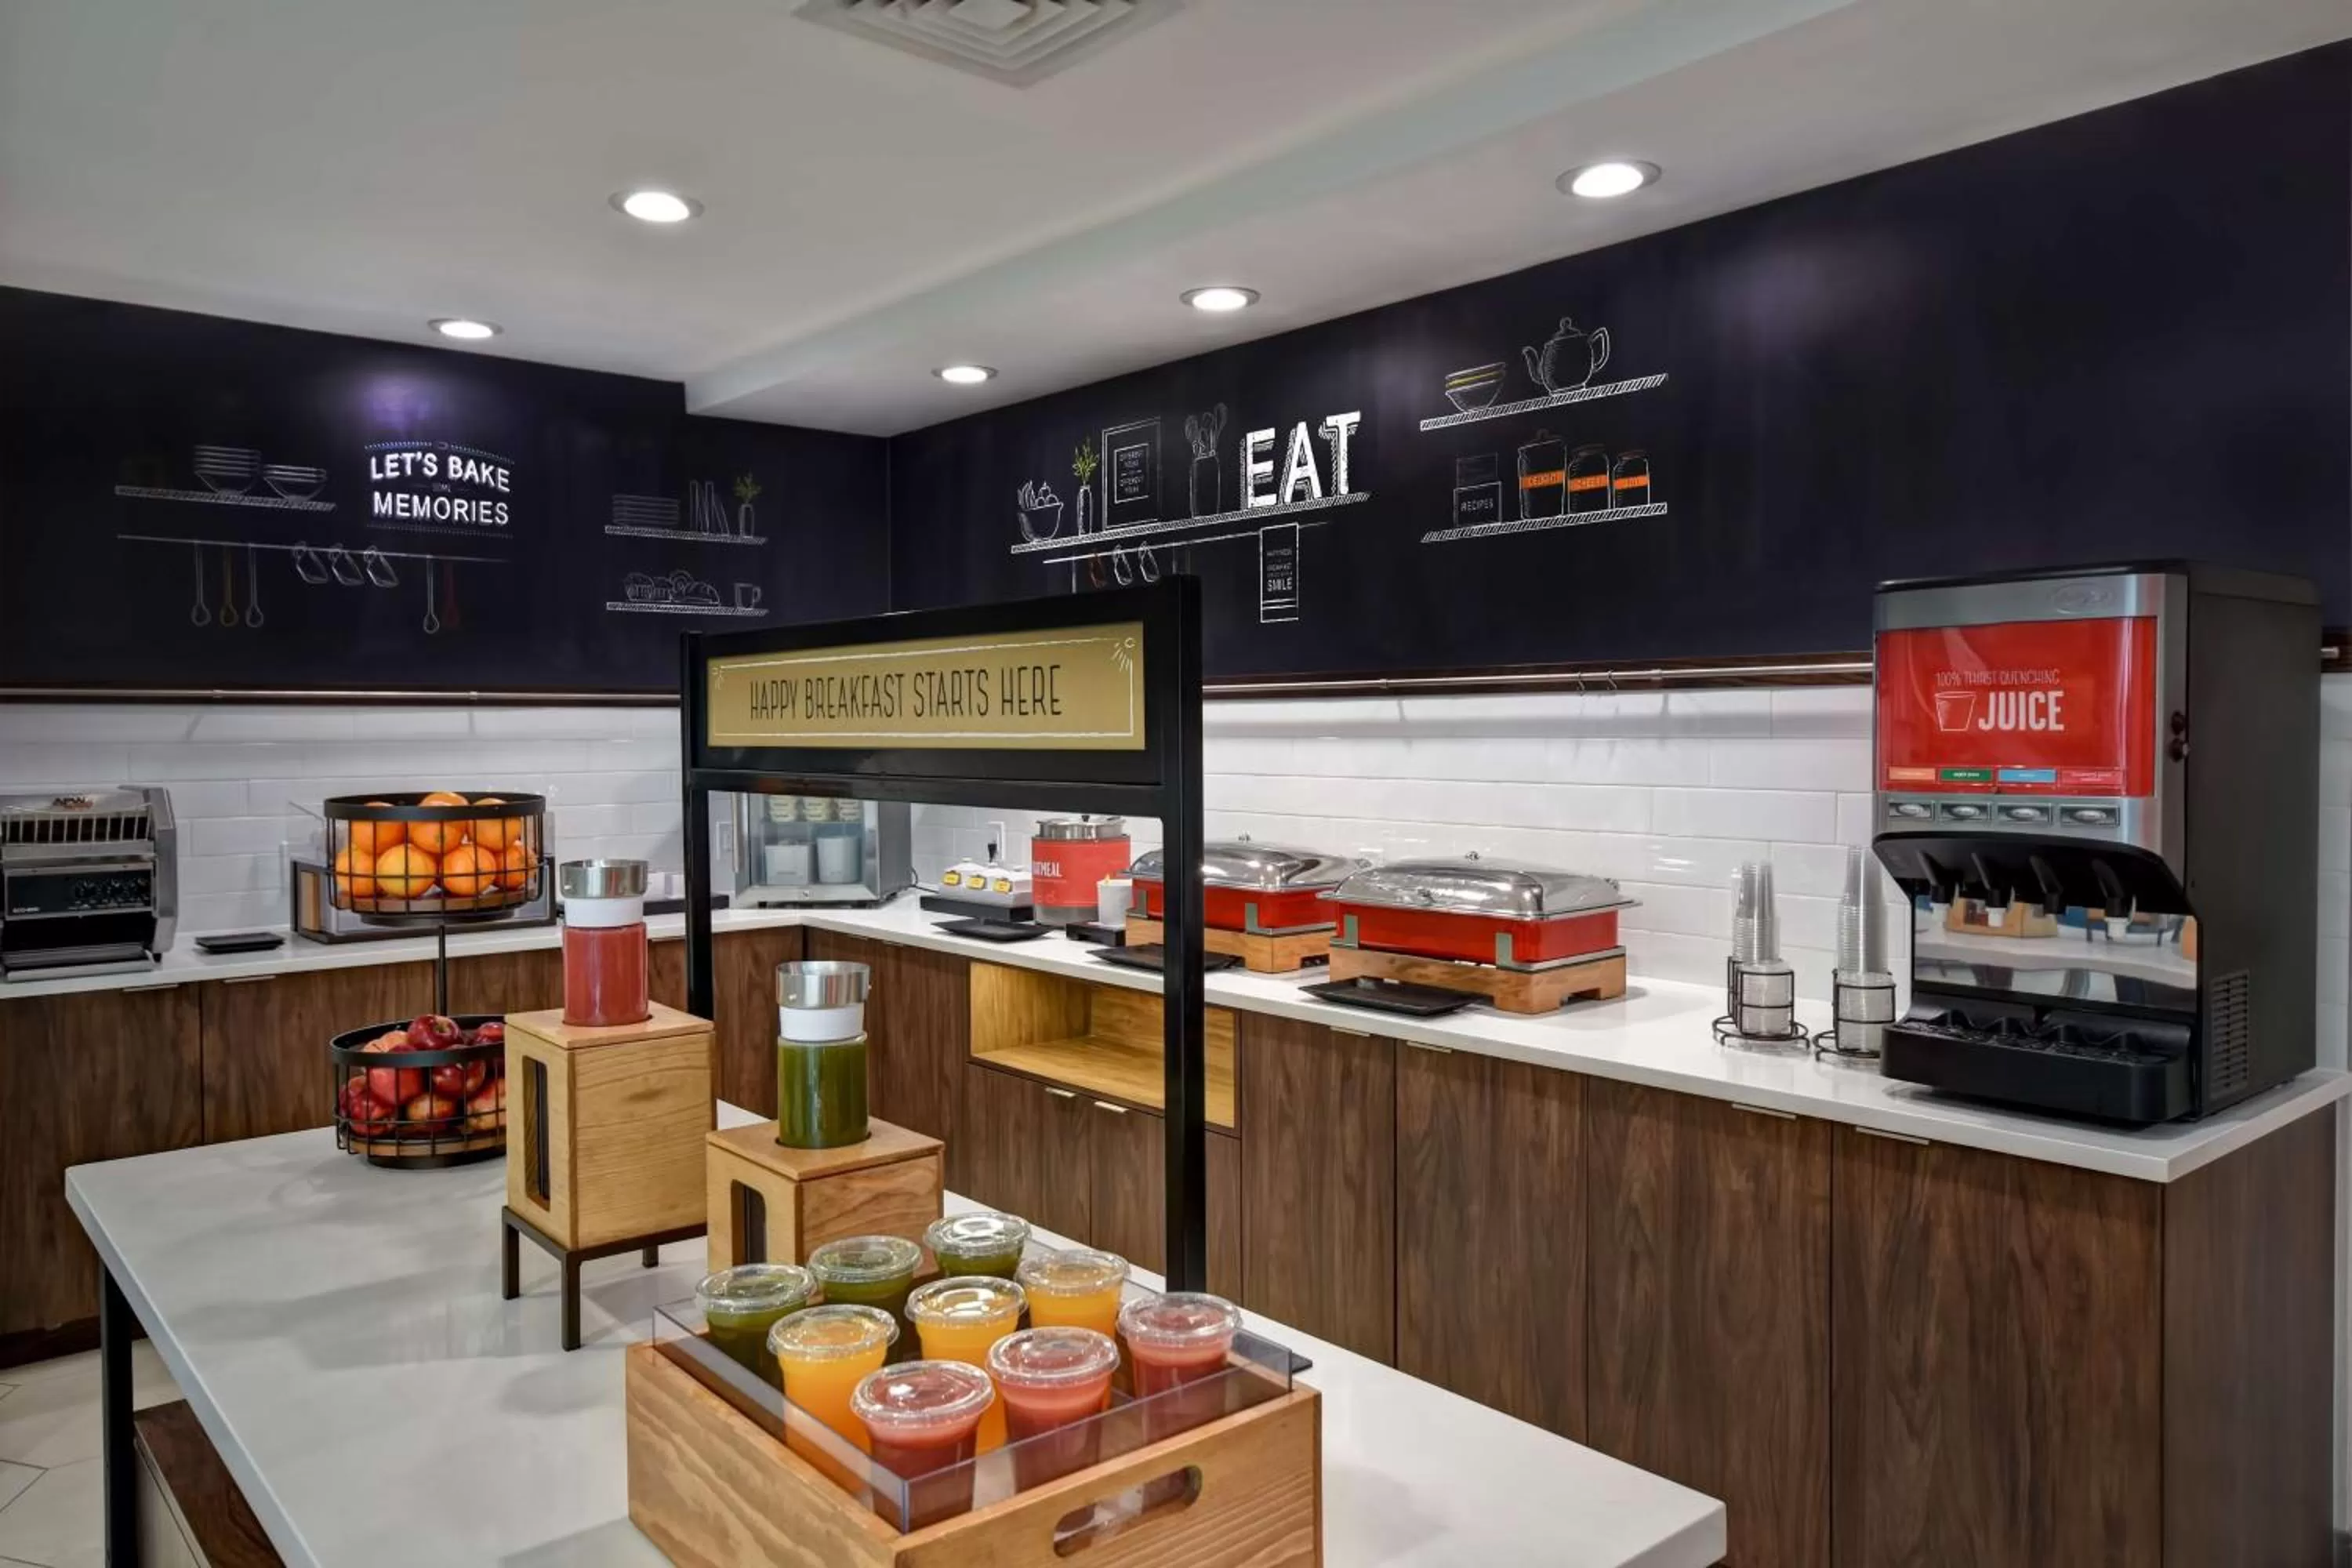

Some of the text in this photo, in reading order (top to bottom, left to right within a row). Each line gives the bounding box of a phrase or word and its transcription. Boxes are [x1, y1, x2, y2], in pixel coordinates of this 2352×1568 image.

[370, 451, 510, 492] LET'S BAKE
[1241, 410, 1361, 509] EAT
[373, 491, 510, 524] MEMORIES
[1461, 498, 1494, 511] RECIPES
[1267, 577, 1293, 592] SMILE
[750, 665, 1062, 720] HAPPY BREAKFAST STARTS HERE
[1935, 668, 2060, 687] 100% THIRST QUENCHING
[1978, 691, 2065, 731] JUICE
